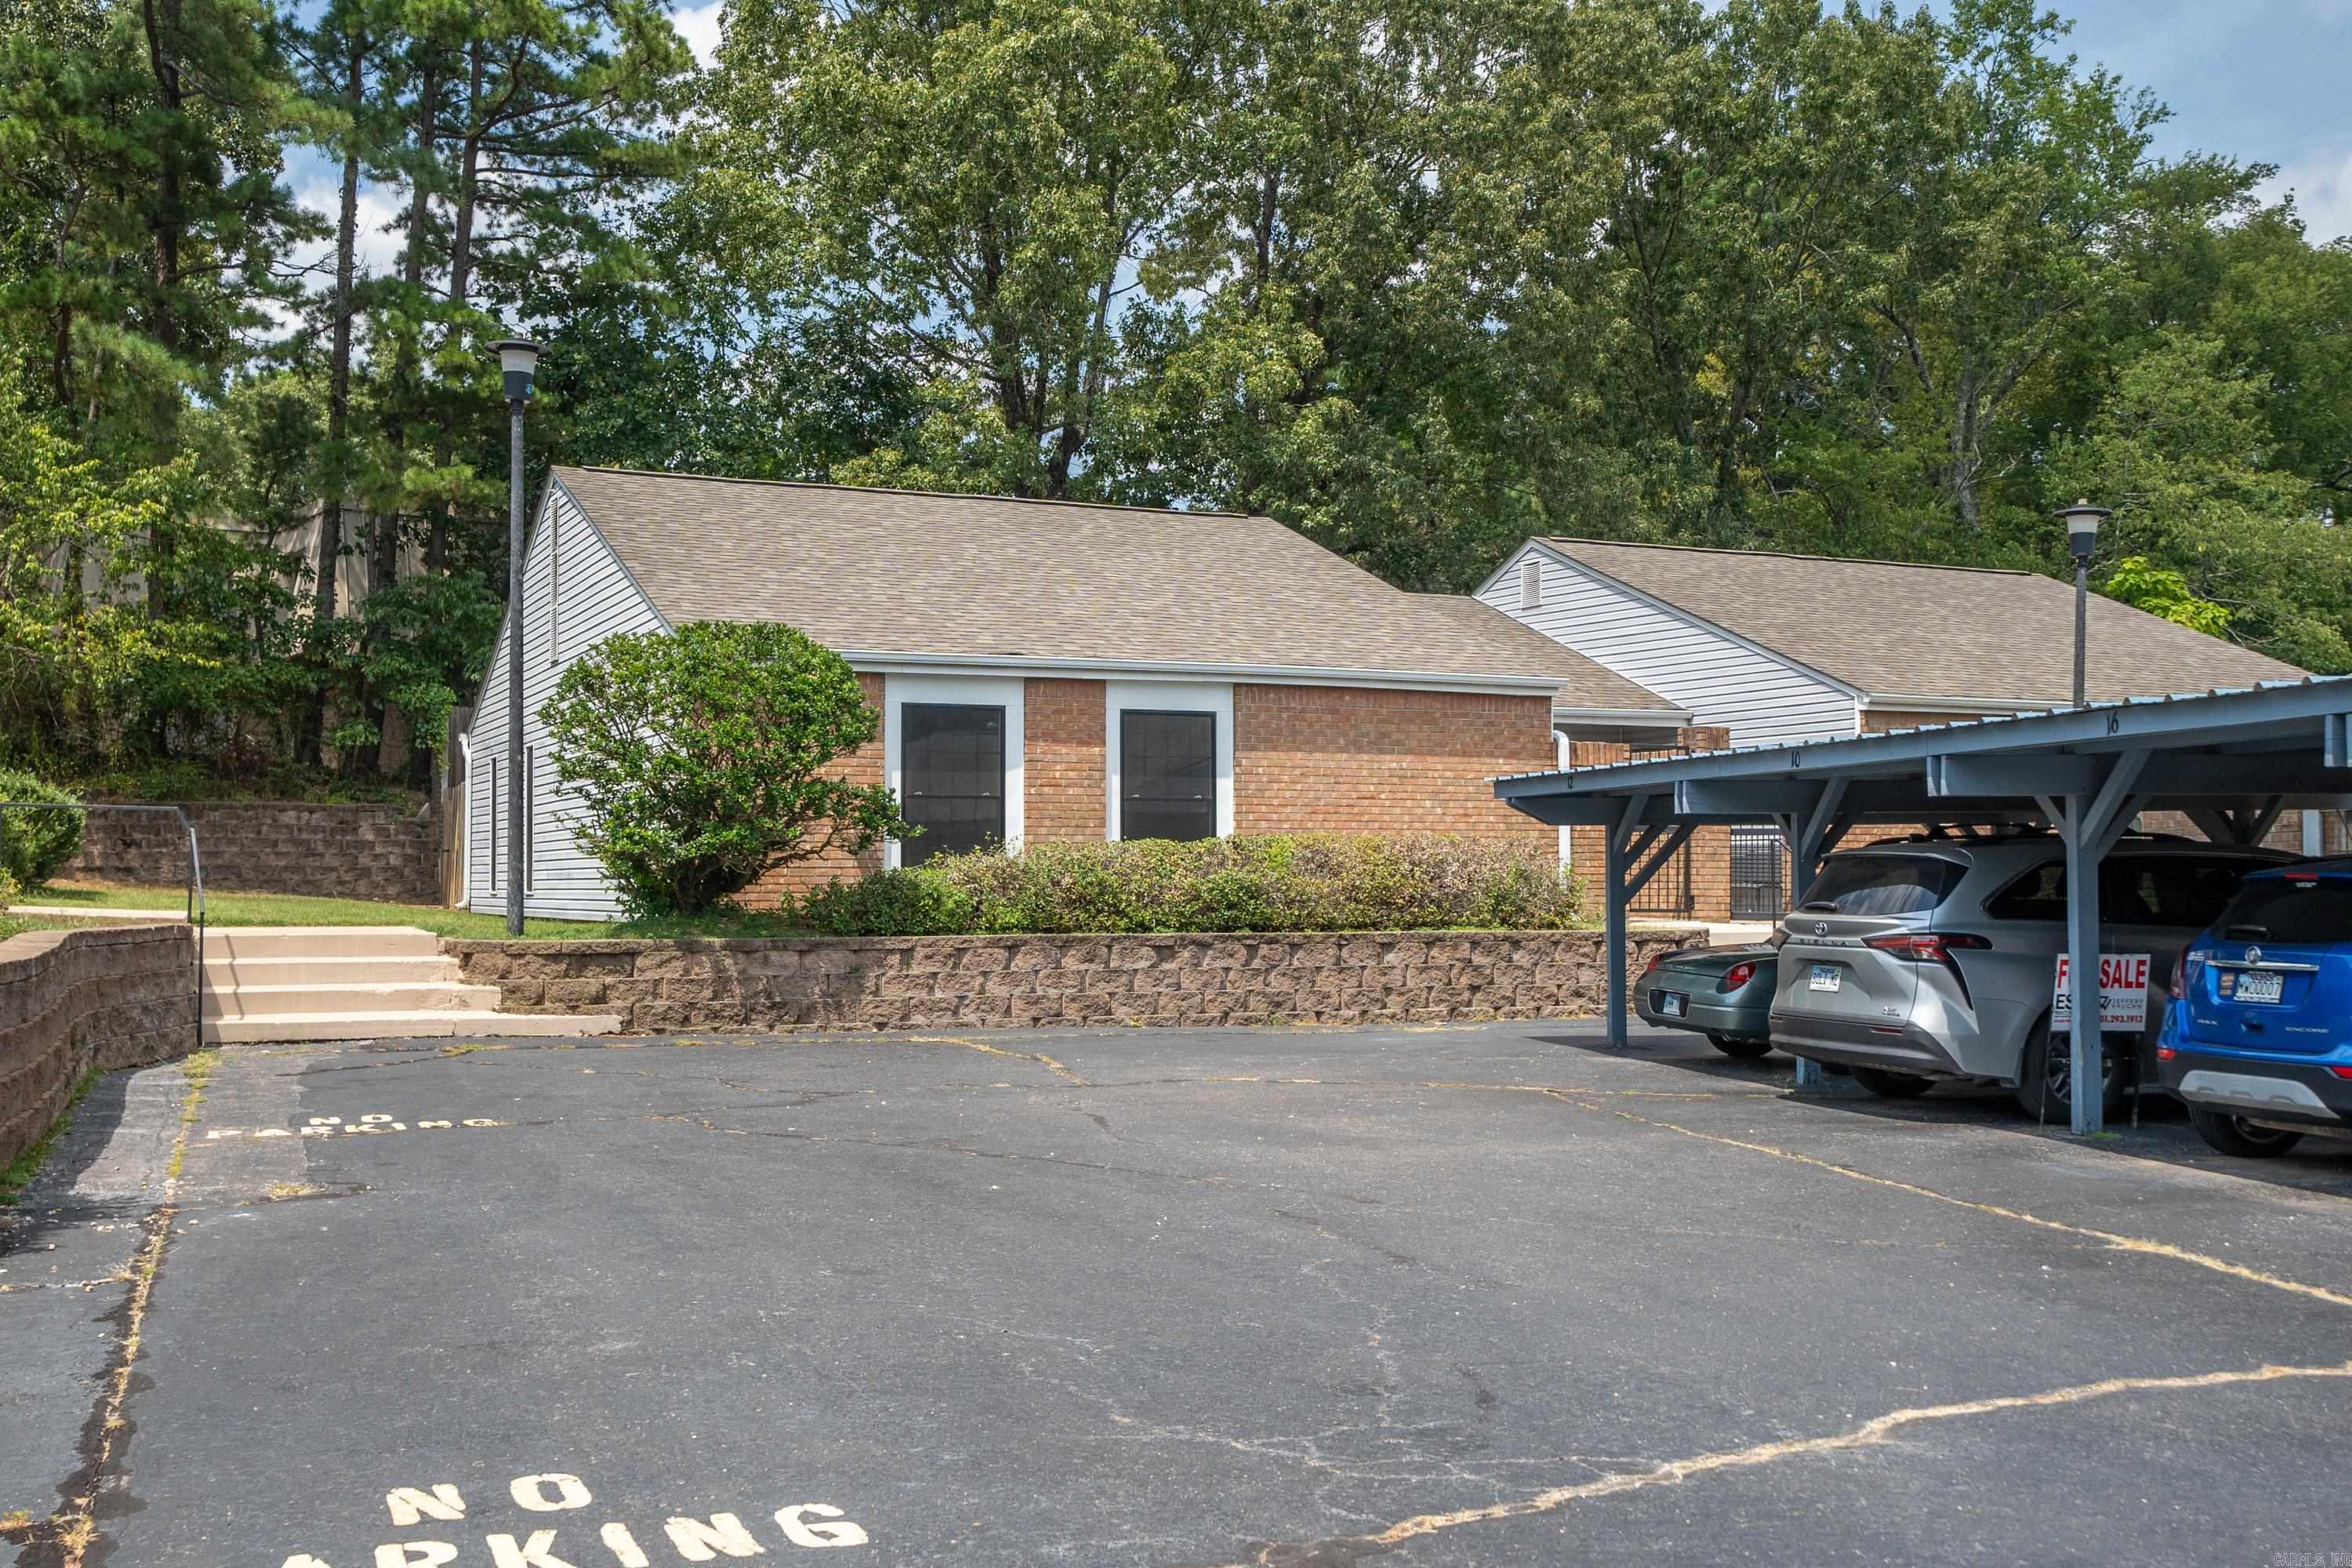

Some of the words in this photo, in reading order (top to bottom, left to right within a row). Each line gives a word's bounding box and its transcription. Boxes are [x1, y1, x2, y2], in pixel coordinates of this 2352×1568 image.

[2107, 710, 2119, 735] 16
[1791, 750, 1801, 768] 10
[2099, 958, 2147, 989] SALE
[206, 1118, 498, 1139] PARKING
[309, 1113, 393, 1126] NO
[385, 1472, 593, 1526] NO
